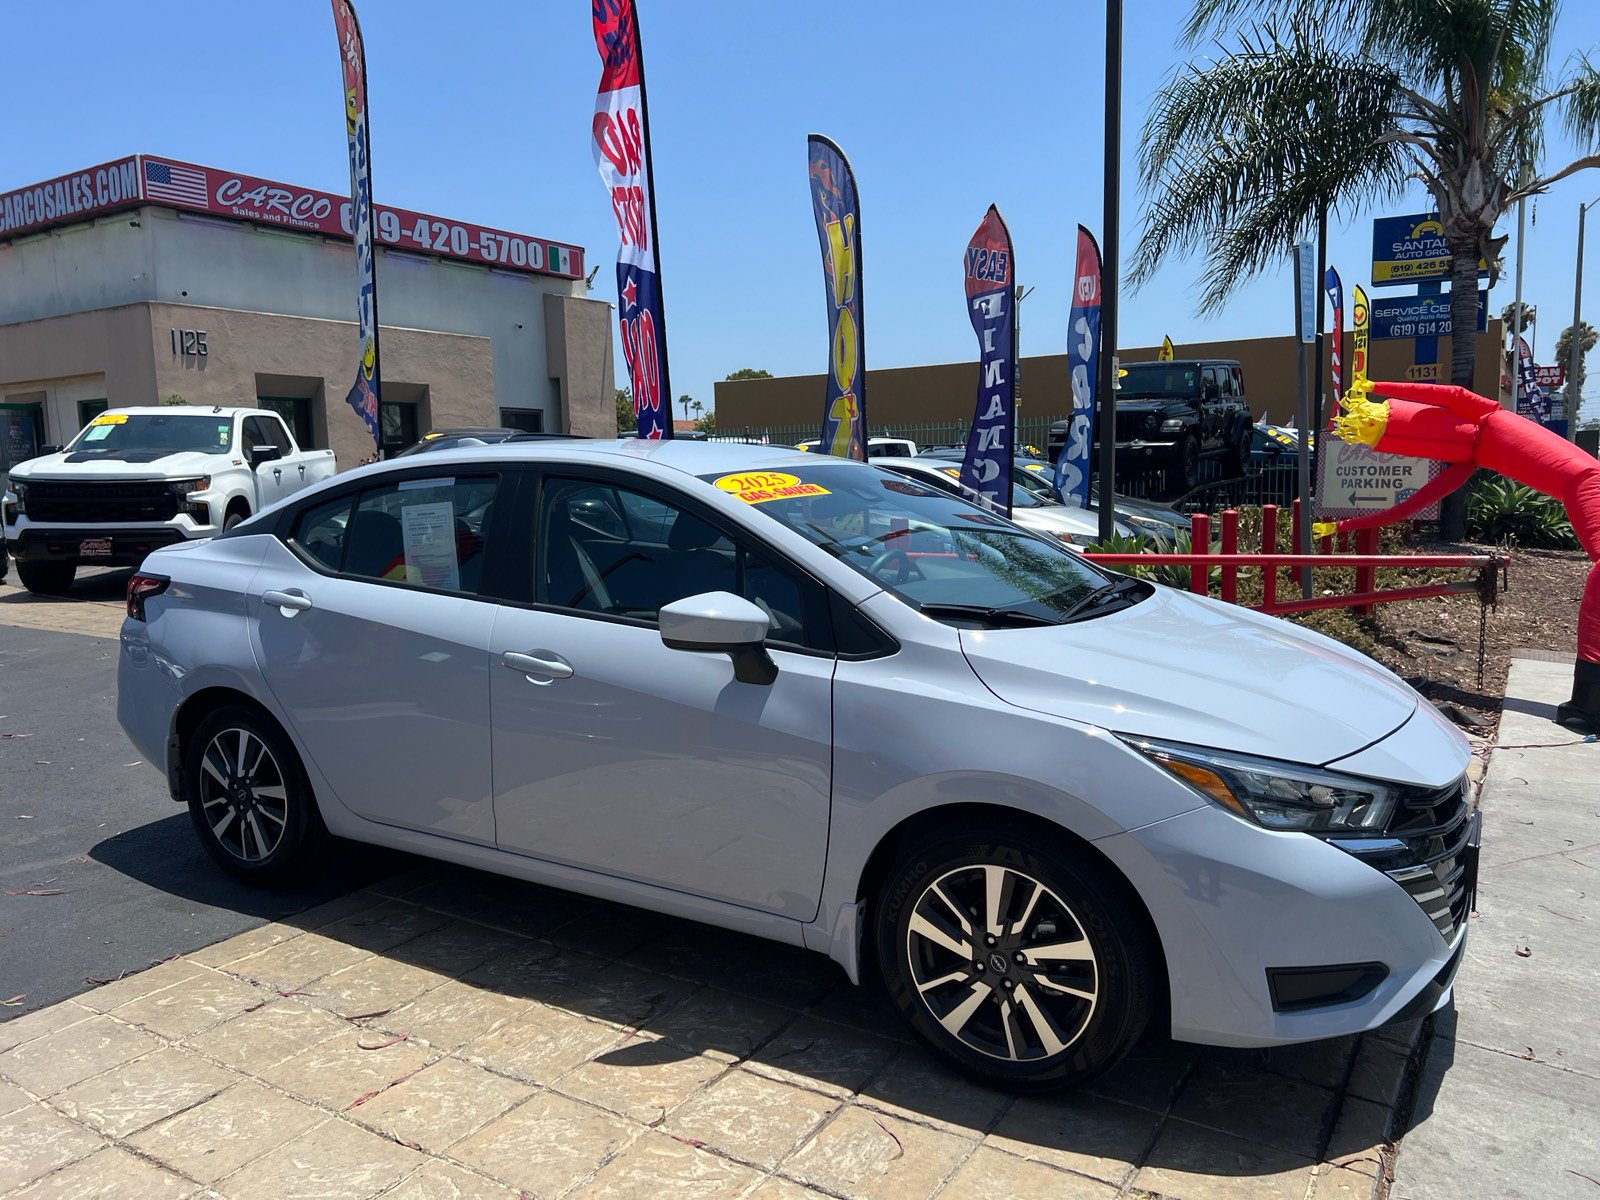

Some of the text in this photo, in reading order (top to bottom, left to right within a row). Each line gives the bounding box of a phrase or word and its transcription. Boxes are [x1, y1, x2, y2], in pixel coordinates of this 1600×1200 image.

[216, 179, 332, 219] CARCO
[232, 206, 320, 229] Sales and Finance
[1395, 251, 1423, 260] AUTO
[1374, 306, 1428, 318] SERVICE
[1390, 321, 1452, 336] (619) 614 20
[171, 327, 208, 355] 1125
[1409, 366, 1437, 378] 1131
[1336, 466, 1412, 477] CUSTOMER
[731, 474, 786, 491] 2025
[1341, 479, 1403, 489] PARKING
